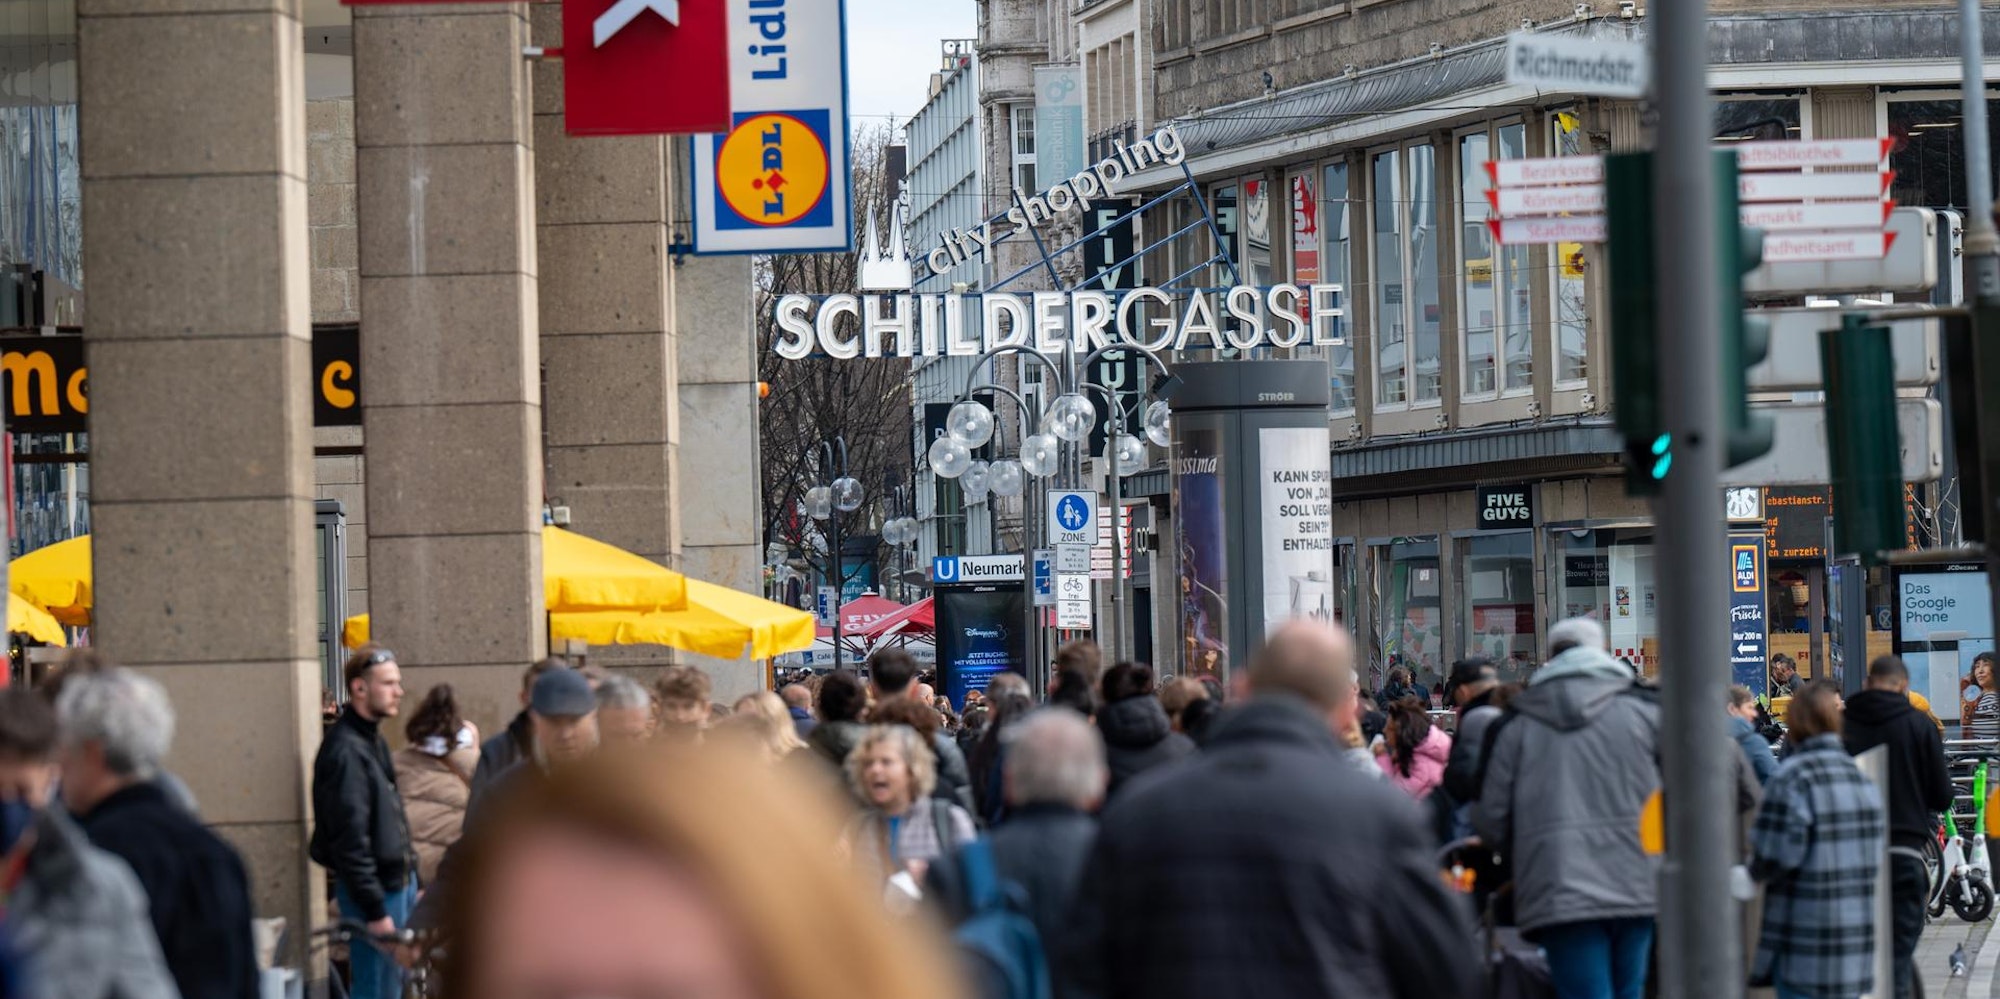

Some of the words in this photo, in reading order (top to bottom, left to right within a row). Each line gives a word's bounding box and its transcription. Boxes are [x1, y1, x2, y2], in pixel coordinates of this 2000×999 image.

[1514, 44, 1636, 83] Richmodstr.
[926, 221, 993, 276] city
[1007, 123, 1186, 235] shopping
[1526, 221, 1606, 238] Stadtmus
[774, 284, 1346, 361] SCHILDERGASSE
[1258, 391, 1295, 402] STRÖER
[1273, 470, 1309, 483] KANN
[1287, 487, 1312, 500] VON
[1487, 493, 1524, 507] FIVE
[1280, 505, 1310, 517] SOLL
[1483, 507, 1530, 520] GUYS
[1061, 532, 1086, 542] ZONE
[1783, 547, 1819, 557] zurzeit
[937, 560, 954, 580] U
[1946, 564, 1979, 572] JCDecaux
[1737, 571, 1754, 580] ALDI
[1905, 582, 1931, 595] Das
[1905, 596, 1956, 611] Google
[1730, 604, 1762, 623] Frische
[1906, 611, 1949, 623] Phone
[1744, 632, 1755, 640] 200
